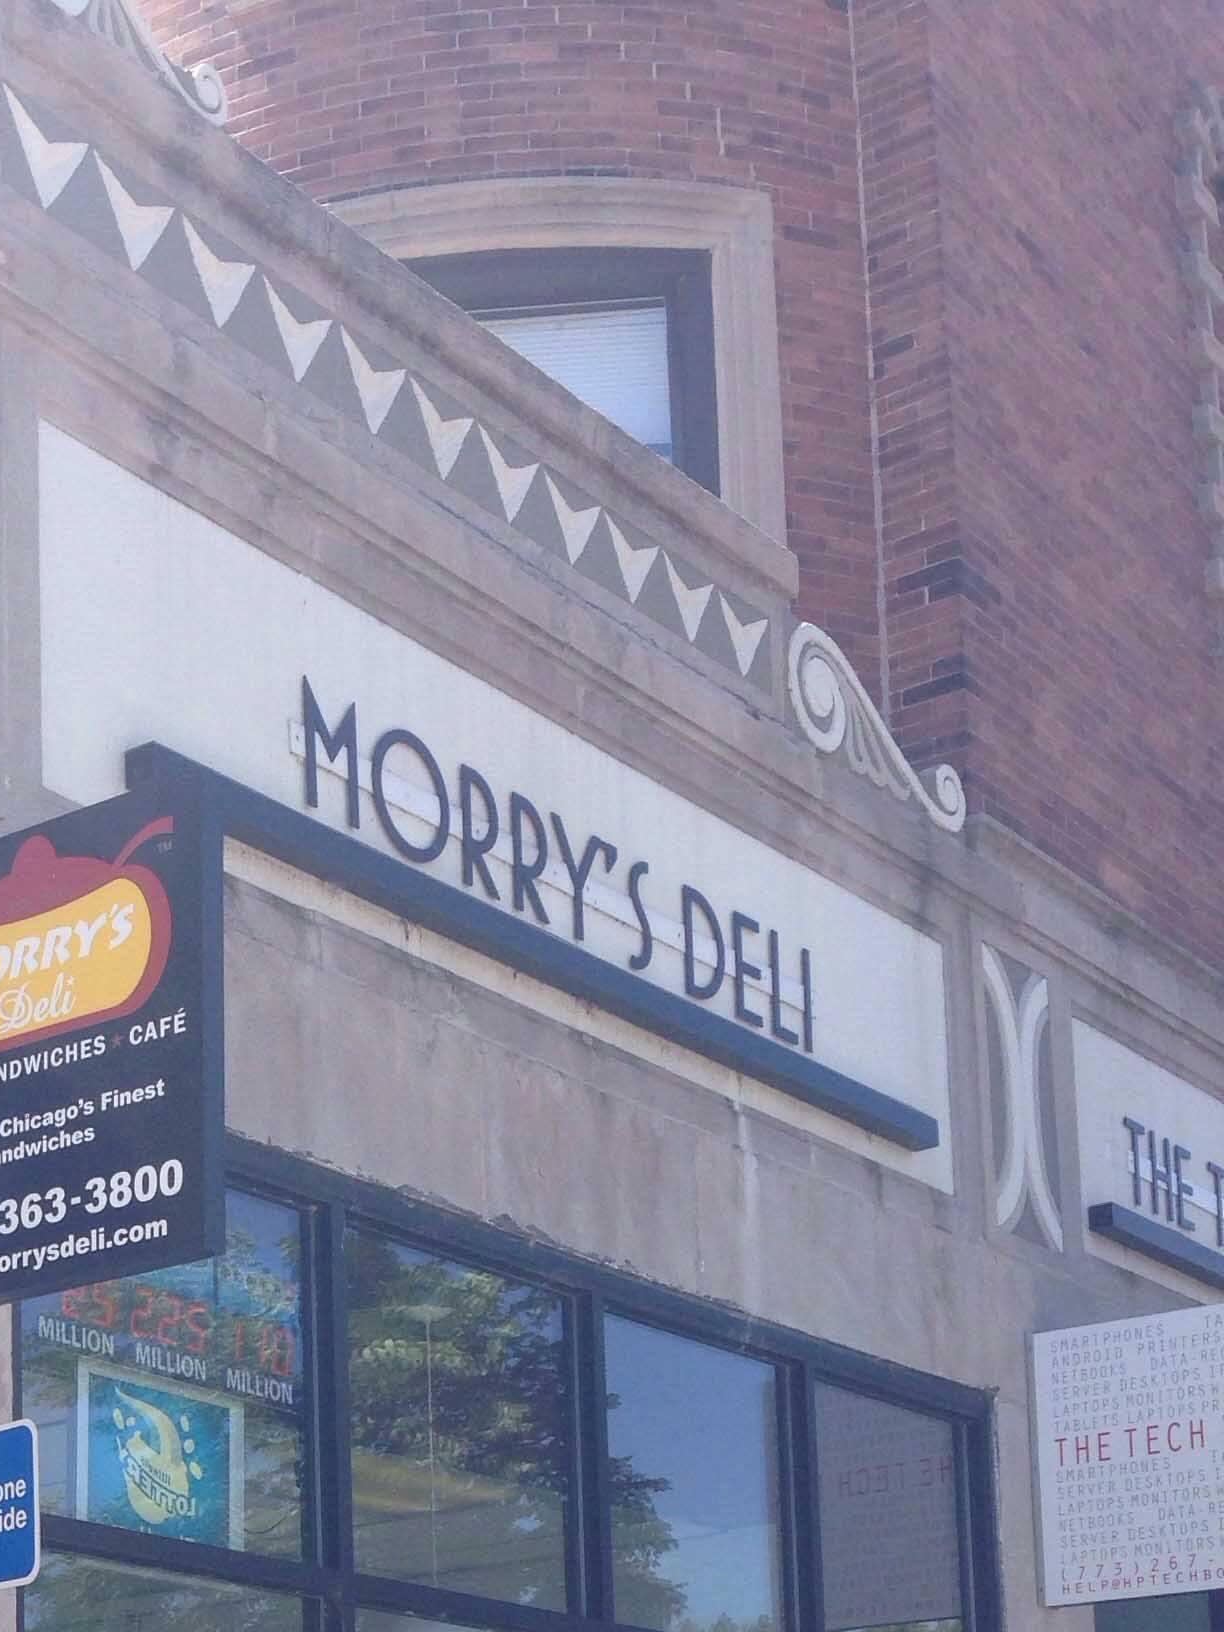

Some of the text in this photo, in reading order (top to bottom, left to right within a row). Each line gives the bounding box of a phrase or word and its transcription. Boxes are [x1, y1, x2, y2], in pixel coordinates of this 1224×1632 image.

[302, 675, 813, 1053] MORRY'S DELI
[129, 1008, 187, 1046] CAFÉ
[0, 1098, 94, 1138] Chicago's
[100, 1078, 166, 1112] Finest
[1122, 1115, 1196, 1232] THE
[1050, 1323, 1165, 1353] SMARTPHONES
[1052, 1331, 1221, 1368] ANDROID PRINTERS
[38, 1315, 294, 1405] MILLION MILLION MILLION
[1120, 1368, 1200, 1392] DESKTOPS
[1126, 1383, 1206, 1406] MONITORS
[1127, 1404, 1195, 1424] LAPTOPS
[1054, 1419, 1205, 1467] THE TECH
[1056, 1457, 1170, 1483] SMARTPHONES
[1126, 1469, 1206, 1492] DESKTOPS
[1131, 1486, 1210, 1507] MONITORS
[1059, 1512, 1135, 1532] NETBOOKS
[1128, 1520, 1209, 1541] DESKTOPS
